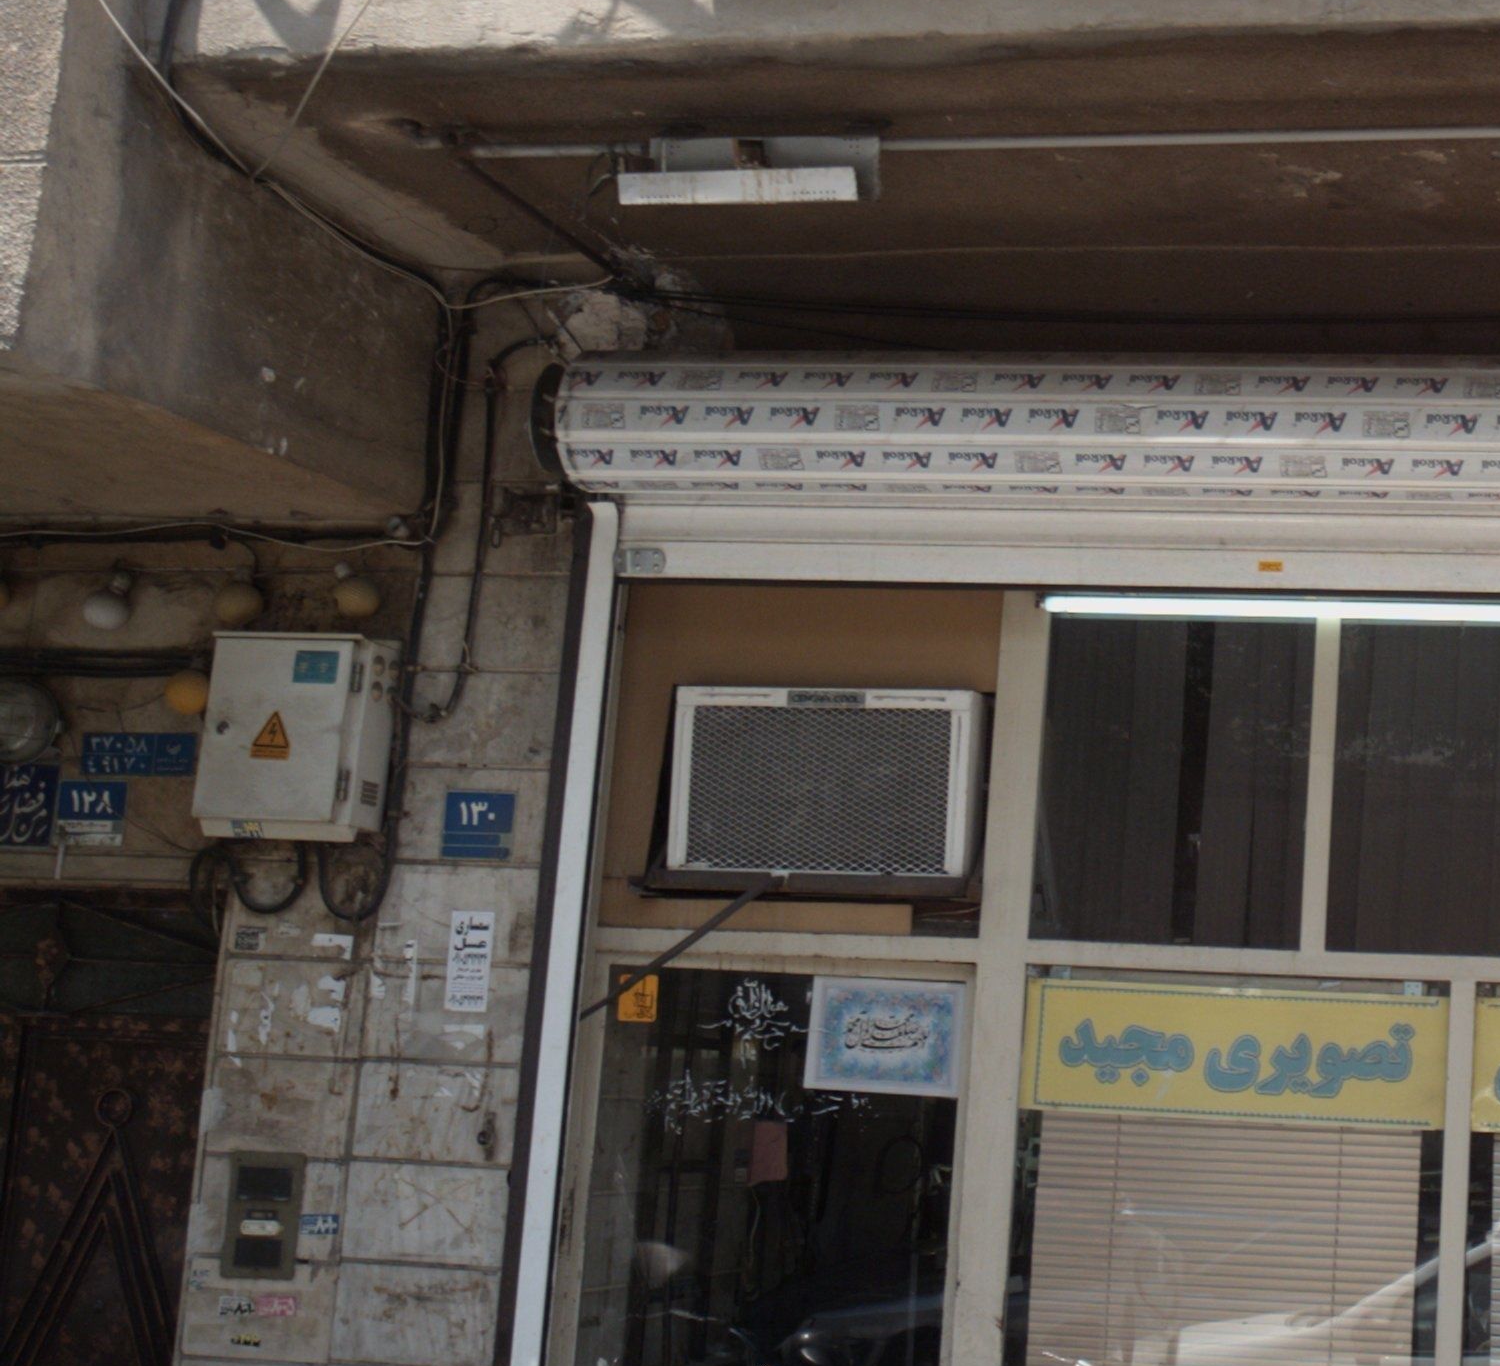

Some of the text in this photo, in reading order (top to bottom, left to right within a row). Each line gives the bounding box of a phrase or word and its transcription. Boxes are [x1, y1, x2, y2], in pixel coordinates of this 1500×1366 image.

[70, 788, 114, 815] ۱۲۸
[459, 801, 496, 826] ۱۳۰
[1057, 1017, 1416, 1096] تصویری مجید
